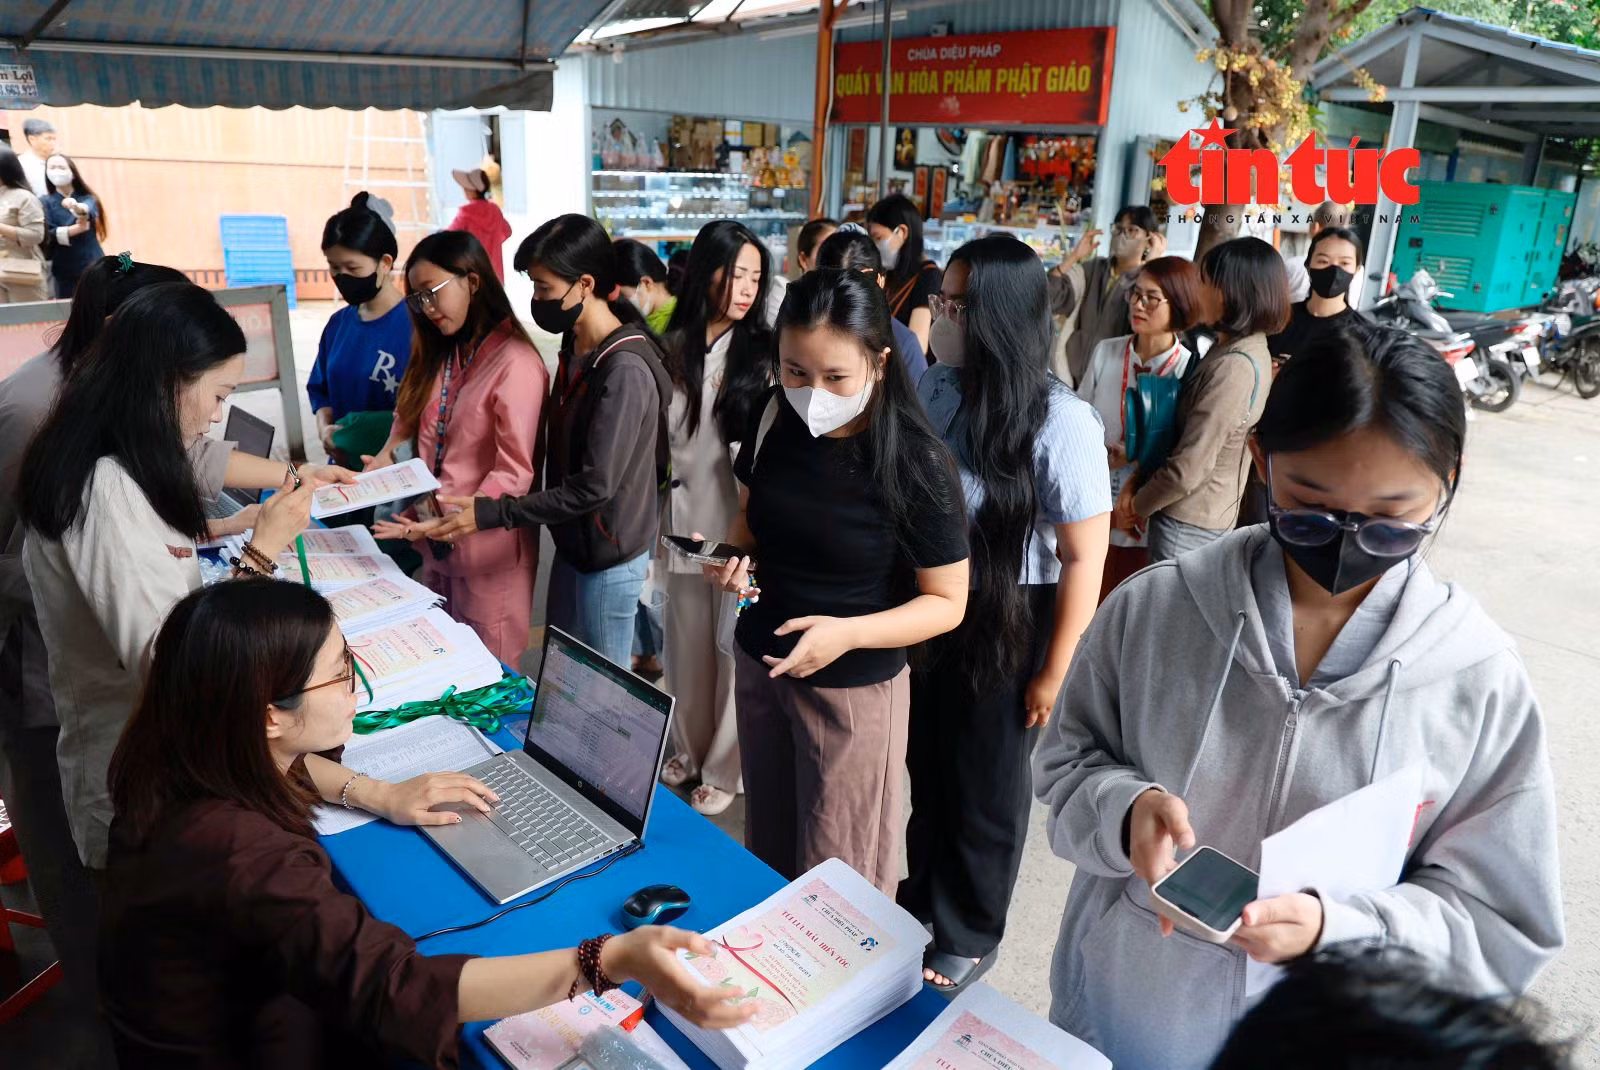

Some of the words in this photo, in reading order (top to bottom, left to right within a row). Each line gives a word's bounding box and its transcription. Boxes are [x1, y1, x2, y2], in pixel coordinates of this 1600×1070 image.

[907, 45, 937, 61] CHÙA
[940, 44, 967, 61] DIỆU
[968, 41, 1002, 59] PHÁP
[908, 65, 938, 95] HÓA
[943, 59, 991, 94] PHẨM
[995, 61, 1042, 98] PHẬT
[1046, 59, 1092, 93] GIÁO
